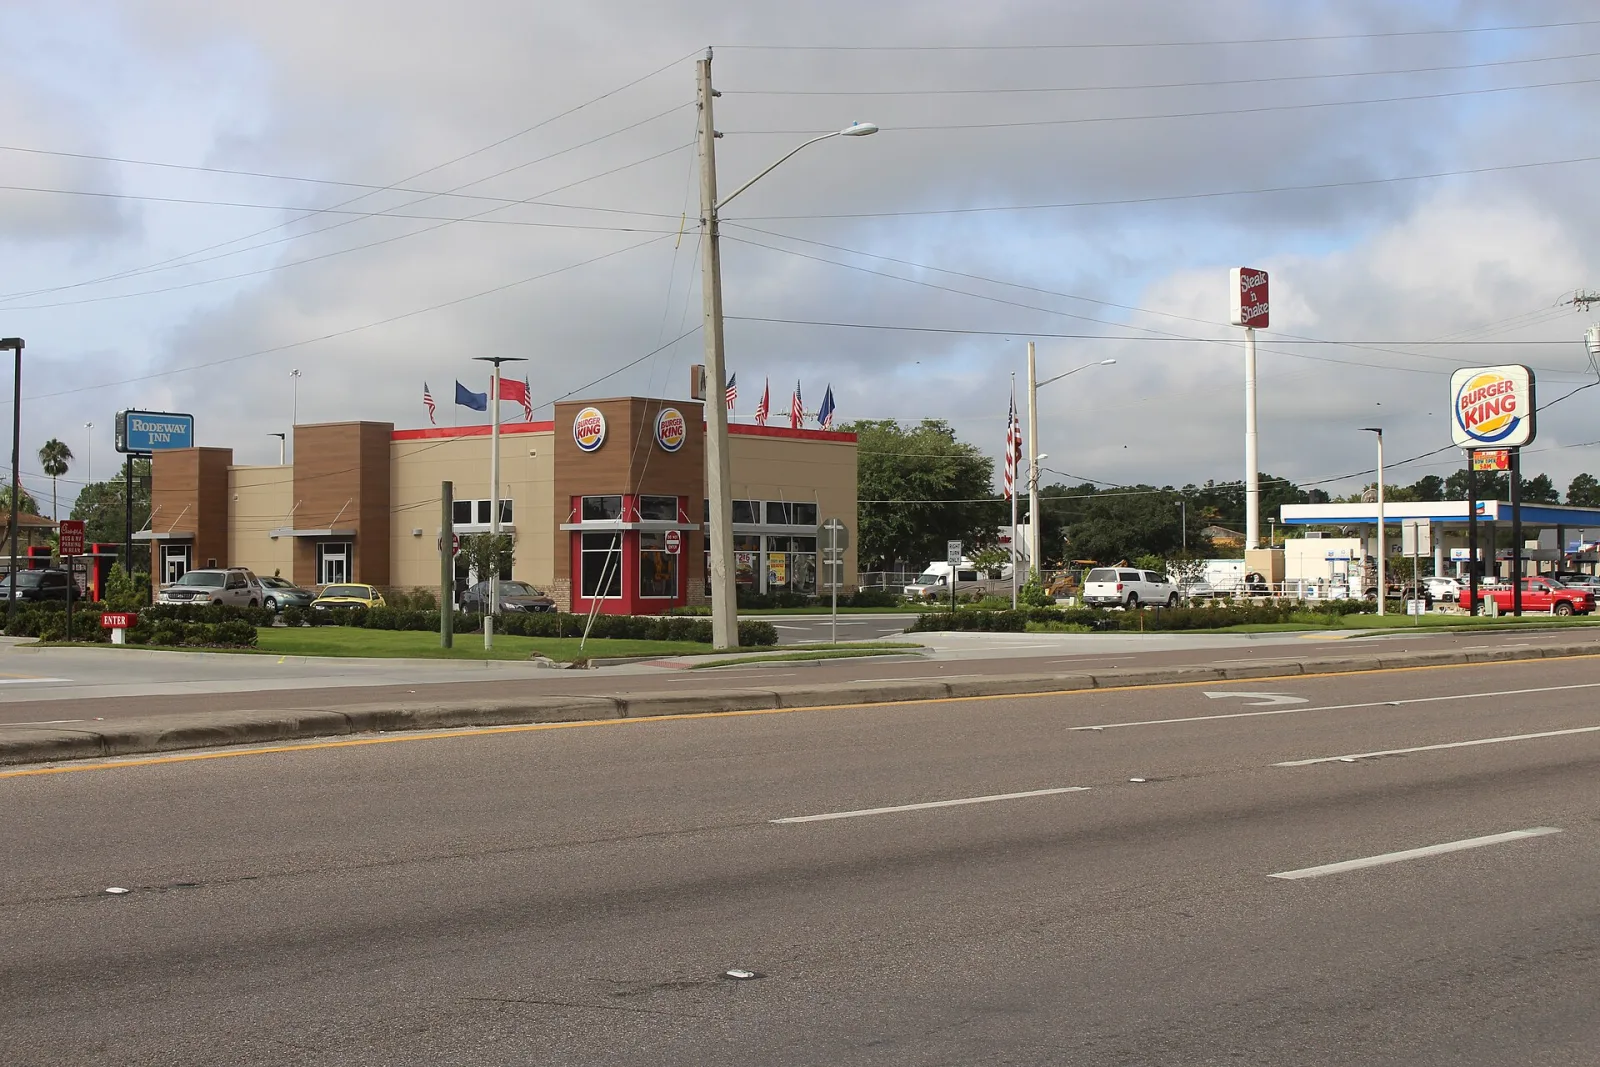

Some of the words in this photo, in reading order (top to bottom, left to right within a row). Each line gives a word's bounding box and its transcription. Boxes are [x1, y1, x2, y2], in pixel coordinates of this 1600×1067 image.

[1241, 272, 1267, 292] Steak
[1241, 302, 1269, 323] Shake
[1461, 380, 1514, 410] BURGER
[1464, 394, 1516, 430] KING
[577, 417, 601, 429] BURGER
[661, 418, 683, 429] BURGER
[577, 425, 601, 440] KING
[661, 426, 683, 440] KING
[103, 615, 126, 625] ENTER
